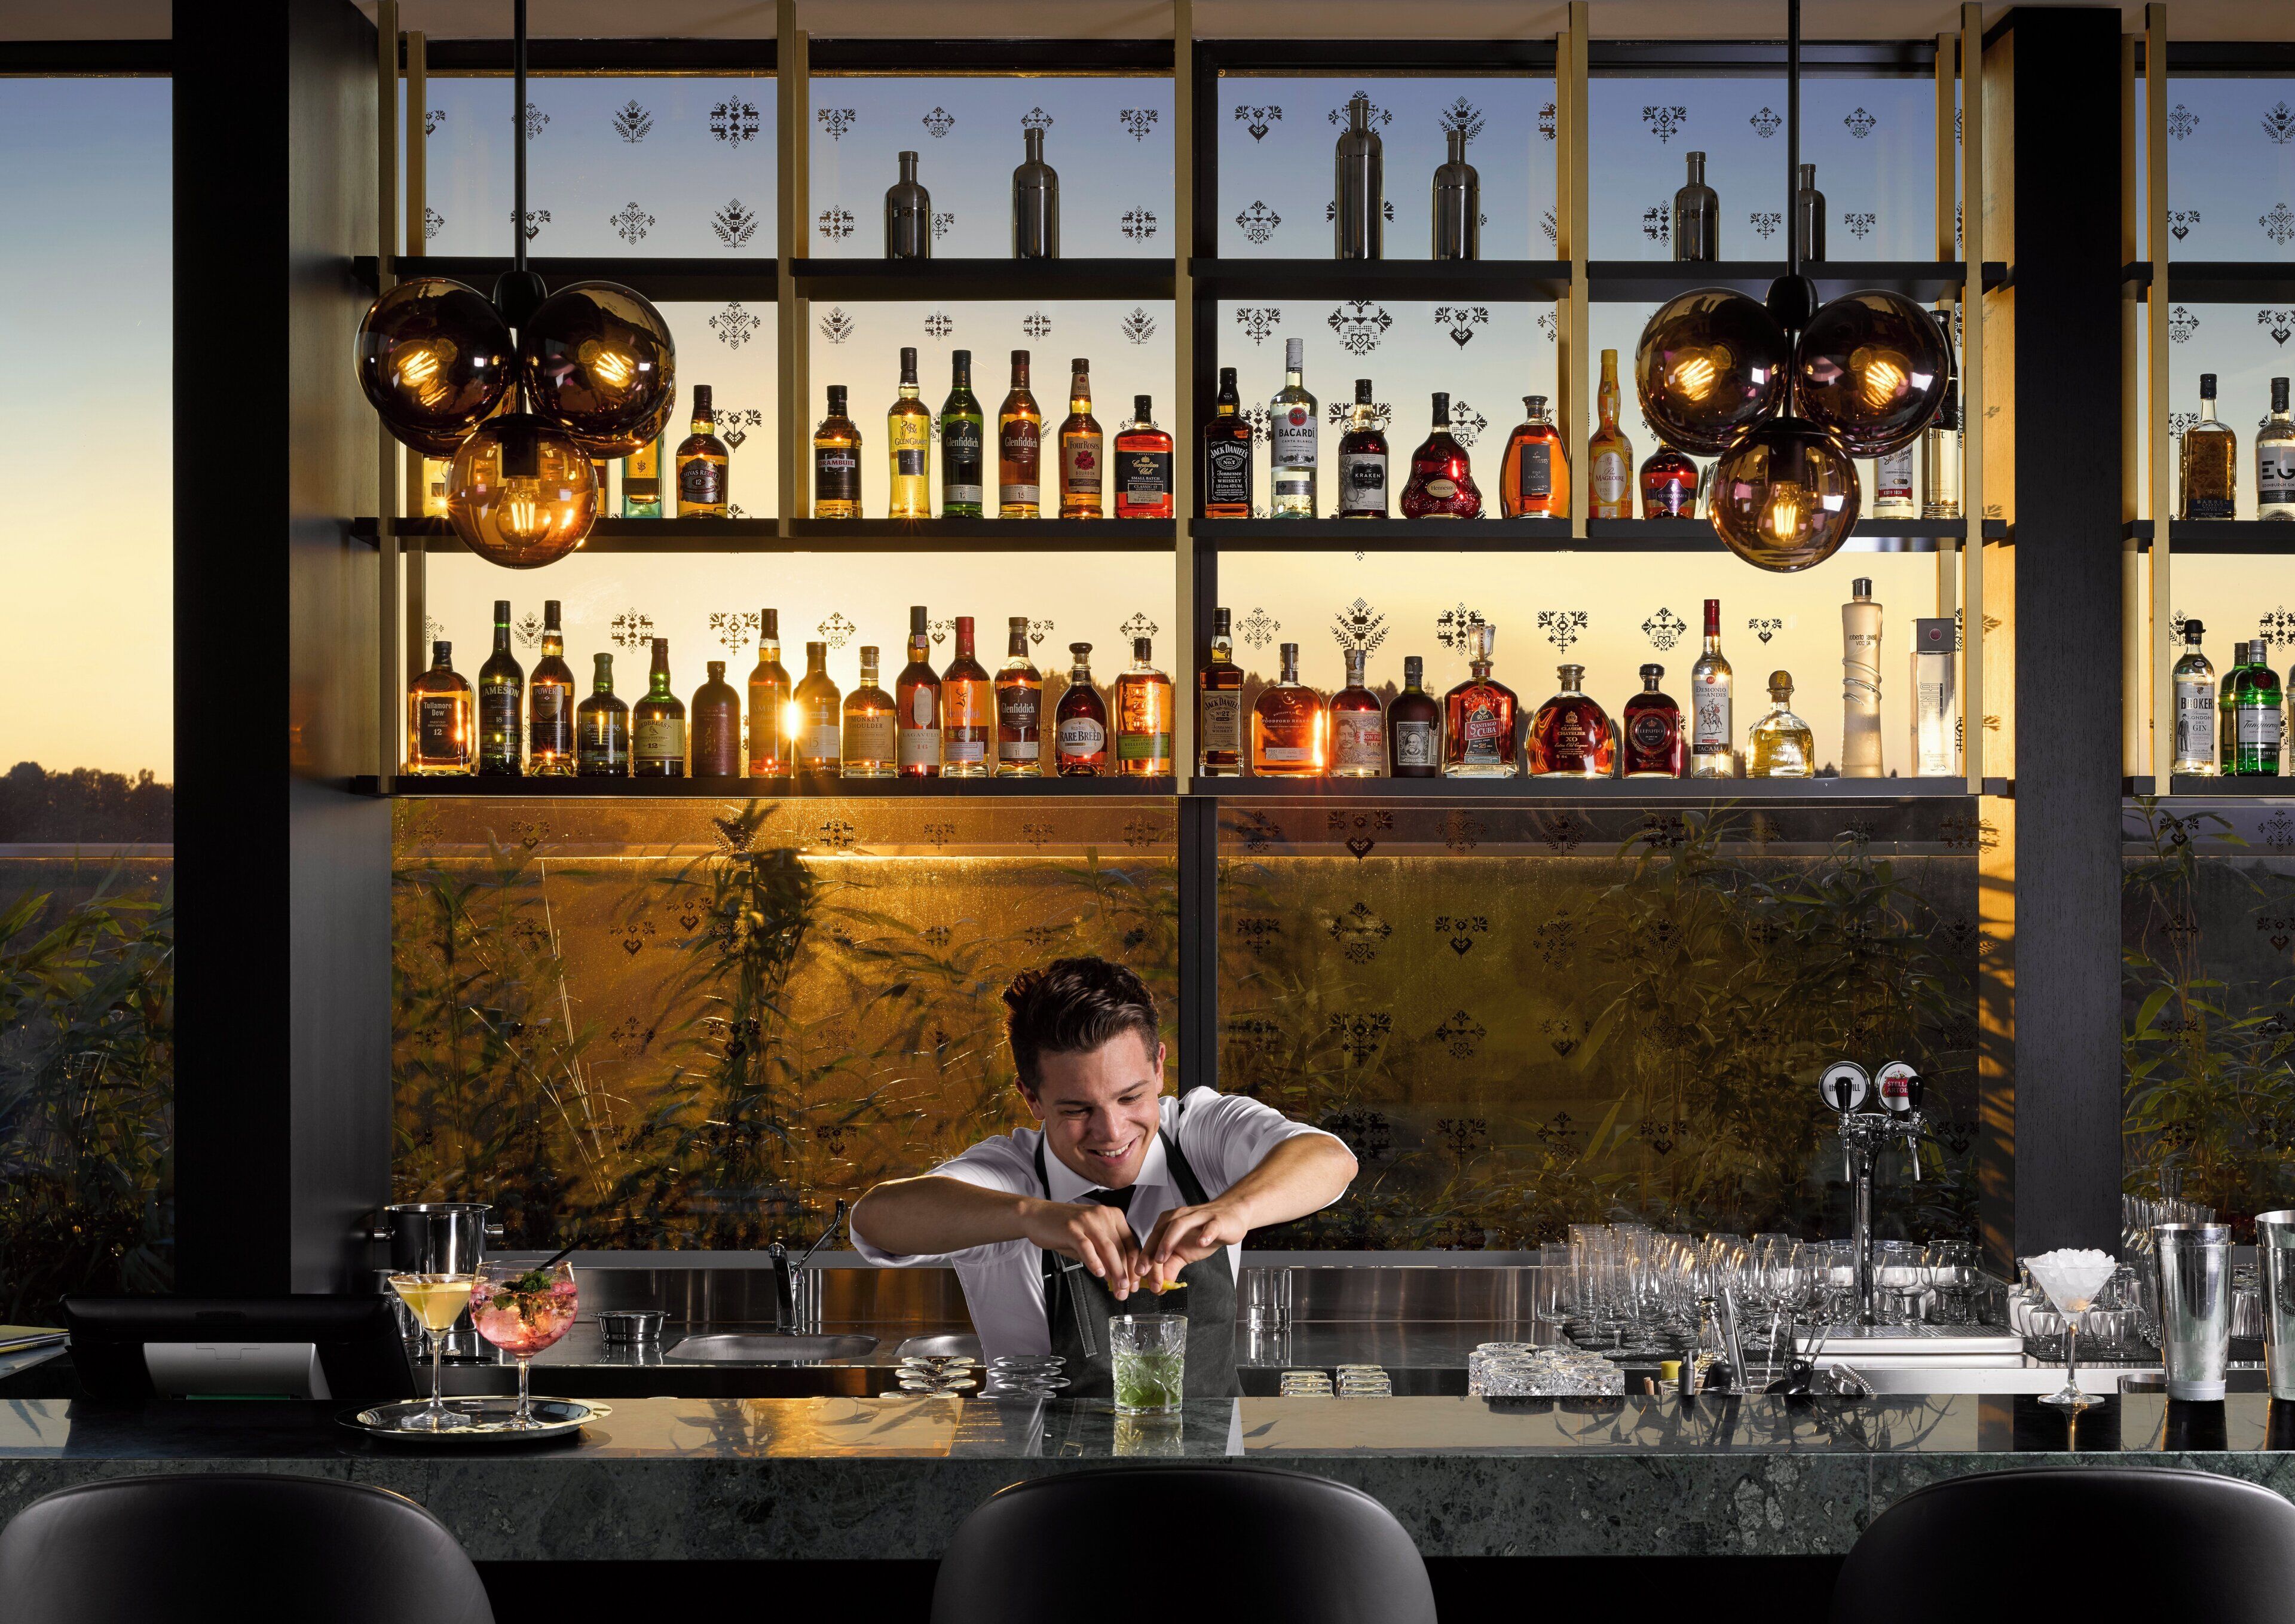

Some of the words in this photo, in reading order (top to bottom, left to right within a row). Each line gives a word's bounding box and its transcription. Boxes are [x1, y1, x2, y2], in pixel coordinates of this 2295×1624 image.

[1279, 427, 1315, 438] BACARDÍ
[1927, 430, 1945, 439] elit
[946, 437, 979, 448] Glenfiddich
[1005, 437, 1038, 448] Glenfiddich
[1070, 441, 1084, 449] Four
[1210, 446, 1225, 458] JACK
[1225, 444, 1249, 458] DANIEL'S
[1132, 459, 1159, 468] Canadian
[681, 470, 699, 479] CHIVAS
[700, 470, 717, 479] REGAL
[482, 686, 519, 698] JAMESON
[1002, 703, 1035, 713] Glenfiddich
[1205, 700, 1219, 710] JACK
[585, 721, 621, 731] Connmra
[638, 720, 671, 730] REDBREAST
[1470, 721, 1497, 736] SANTIAGO
[2244, 720, 2279, 730] Tanqueray
[1060, 731, 1076, 741] RARE
[1078, 731, 1101, 741] BREED
[1477, 727, 1497, 737] CUBA
[809, 737, 819, 747] 15
